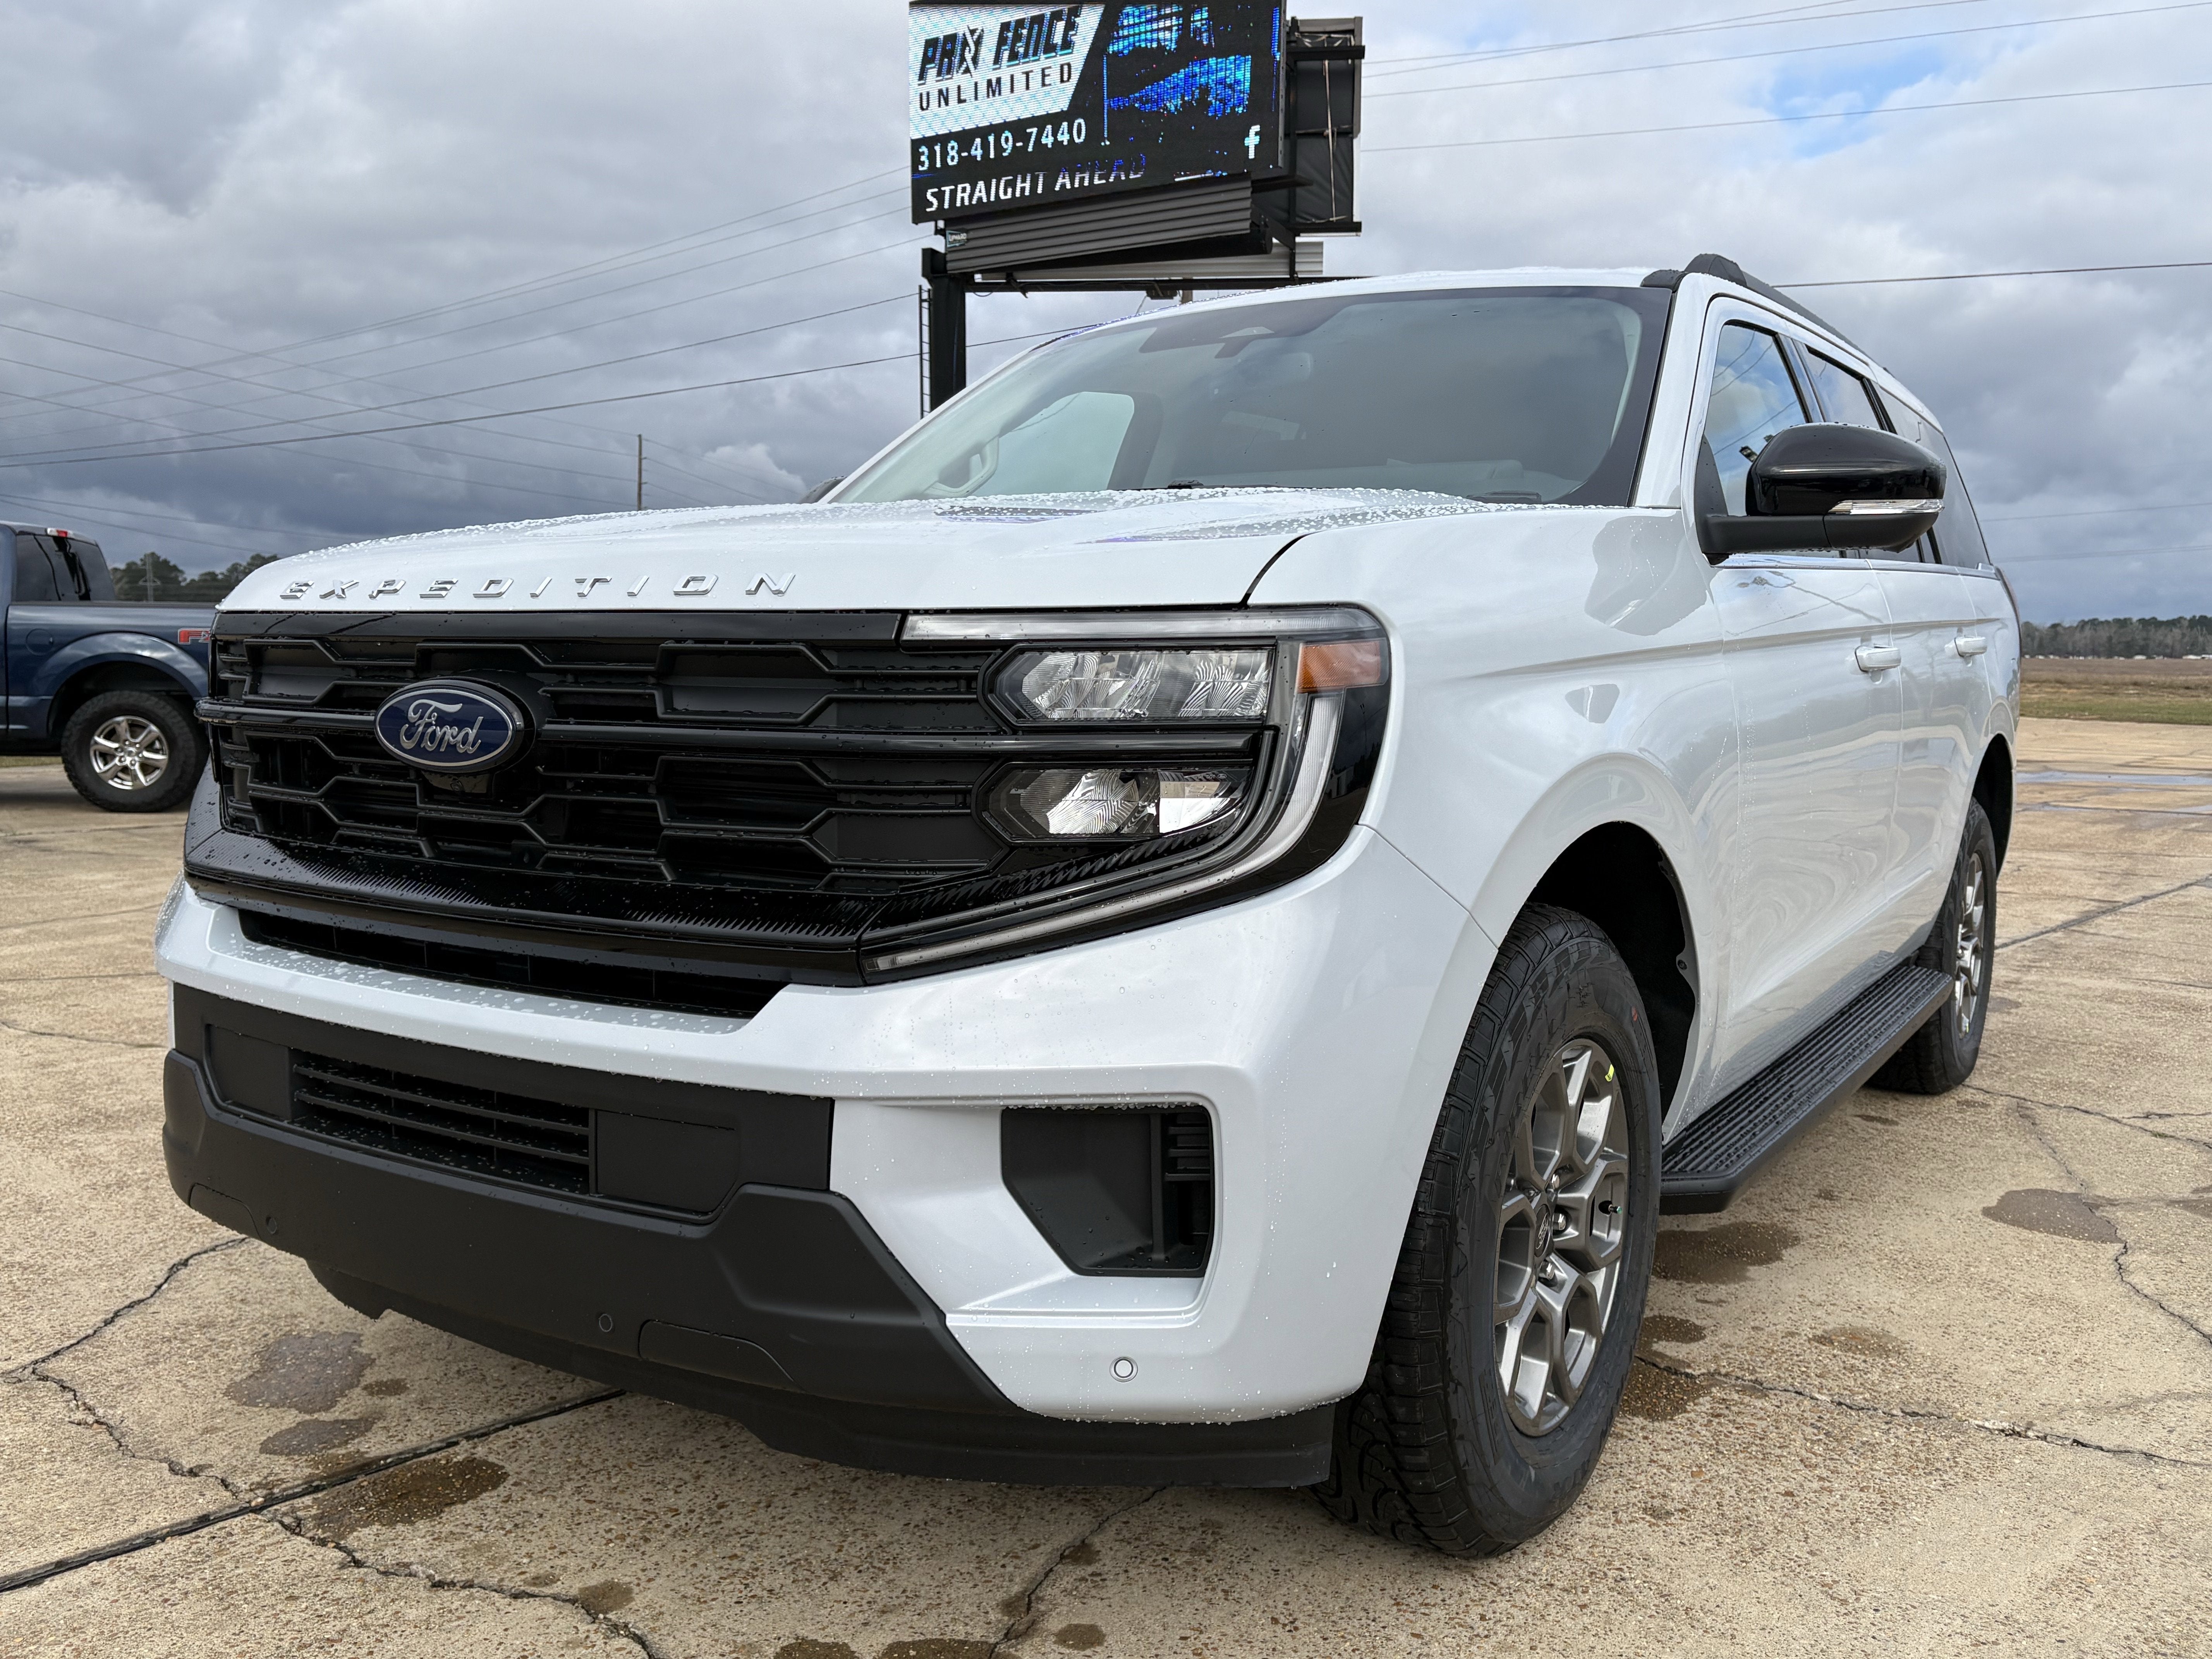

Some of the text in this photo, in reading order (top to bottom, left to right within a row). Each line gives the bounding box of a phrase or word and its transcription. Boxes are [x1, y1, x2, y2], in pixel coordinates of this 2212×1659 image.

[992, 5, 1083, 70] FENCE
[919, 62, 1072, 111] UNLIMITED
[918, 118, 1086, 171] 318-419-7440
[926, 153, 1146, 212] STRAIGHT AHEAD
[280, 572, 797, 600] EXPEDITION
[400, 699, 484, 754] Ford
